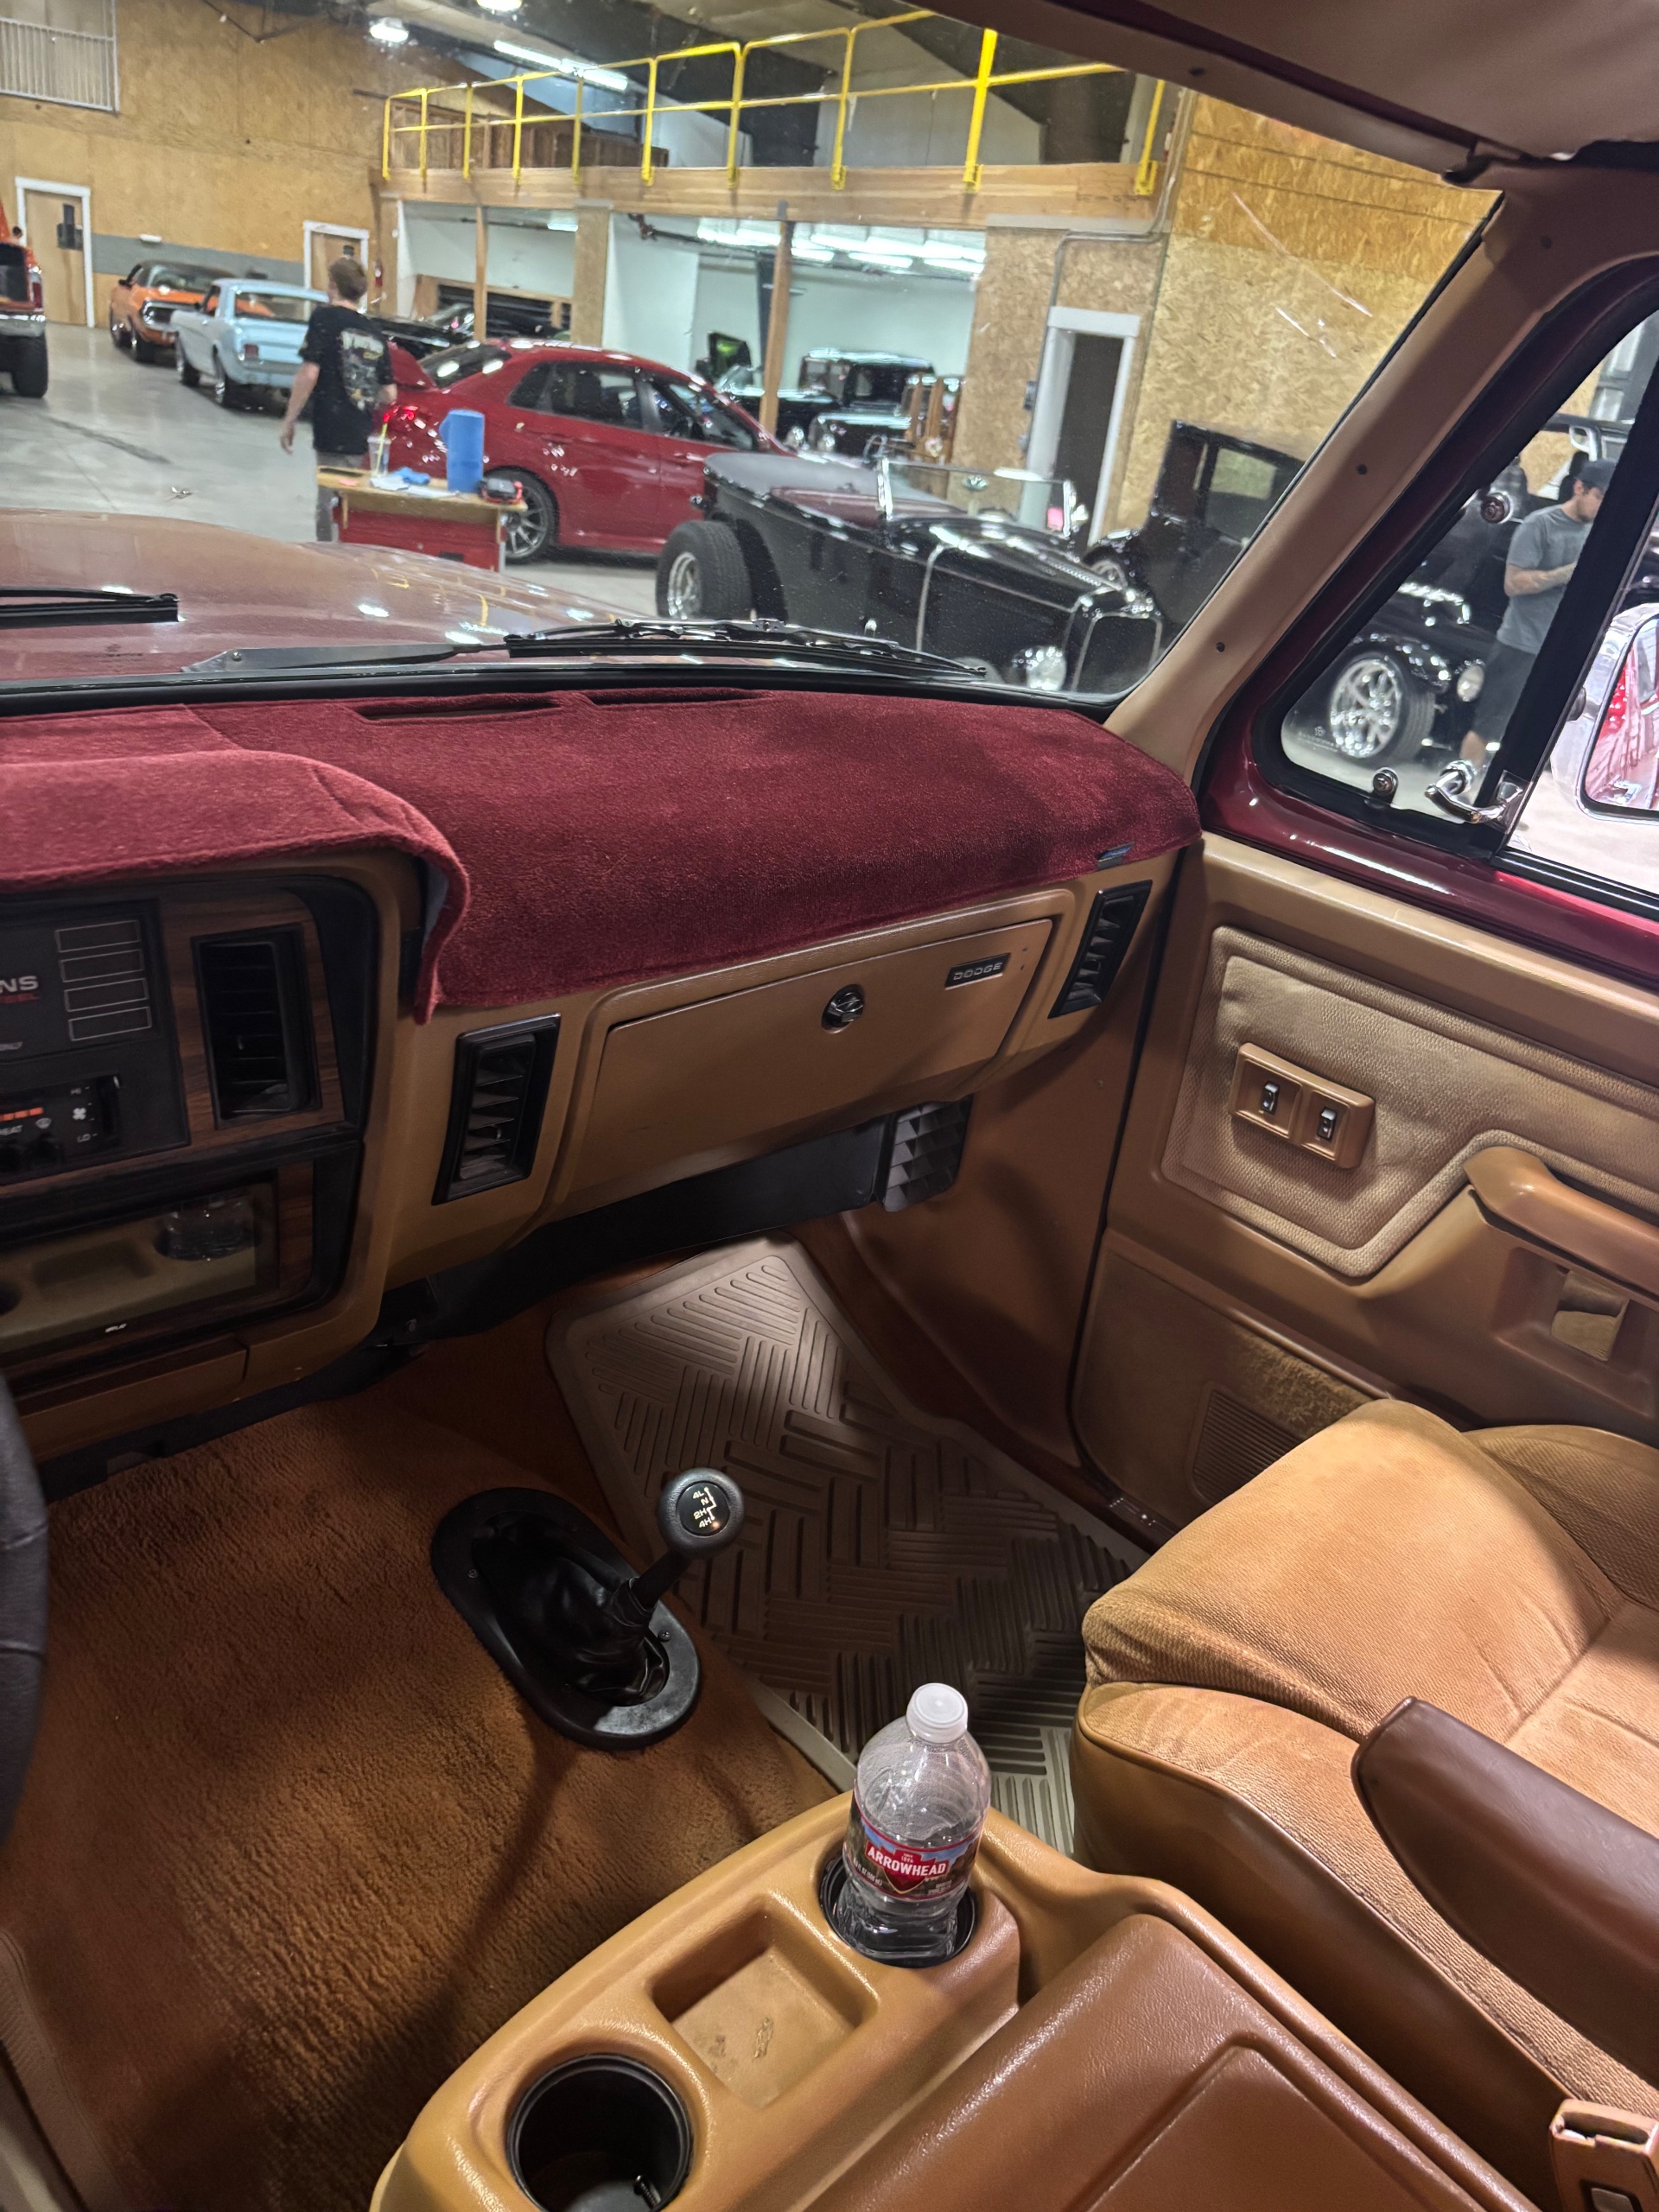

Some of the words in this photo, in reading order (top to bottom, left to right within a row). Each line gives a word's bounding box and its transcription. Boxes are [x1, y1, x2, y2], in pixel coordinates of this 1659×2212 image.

[953, 962, 1002, 981] DODGE
[694, 1508, 707, 1519] 2H
[699, 1517, 712, 1528] 4H
[868, 1846, 947, 1876] ARROWHEAD
